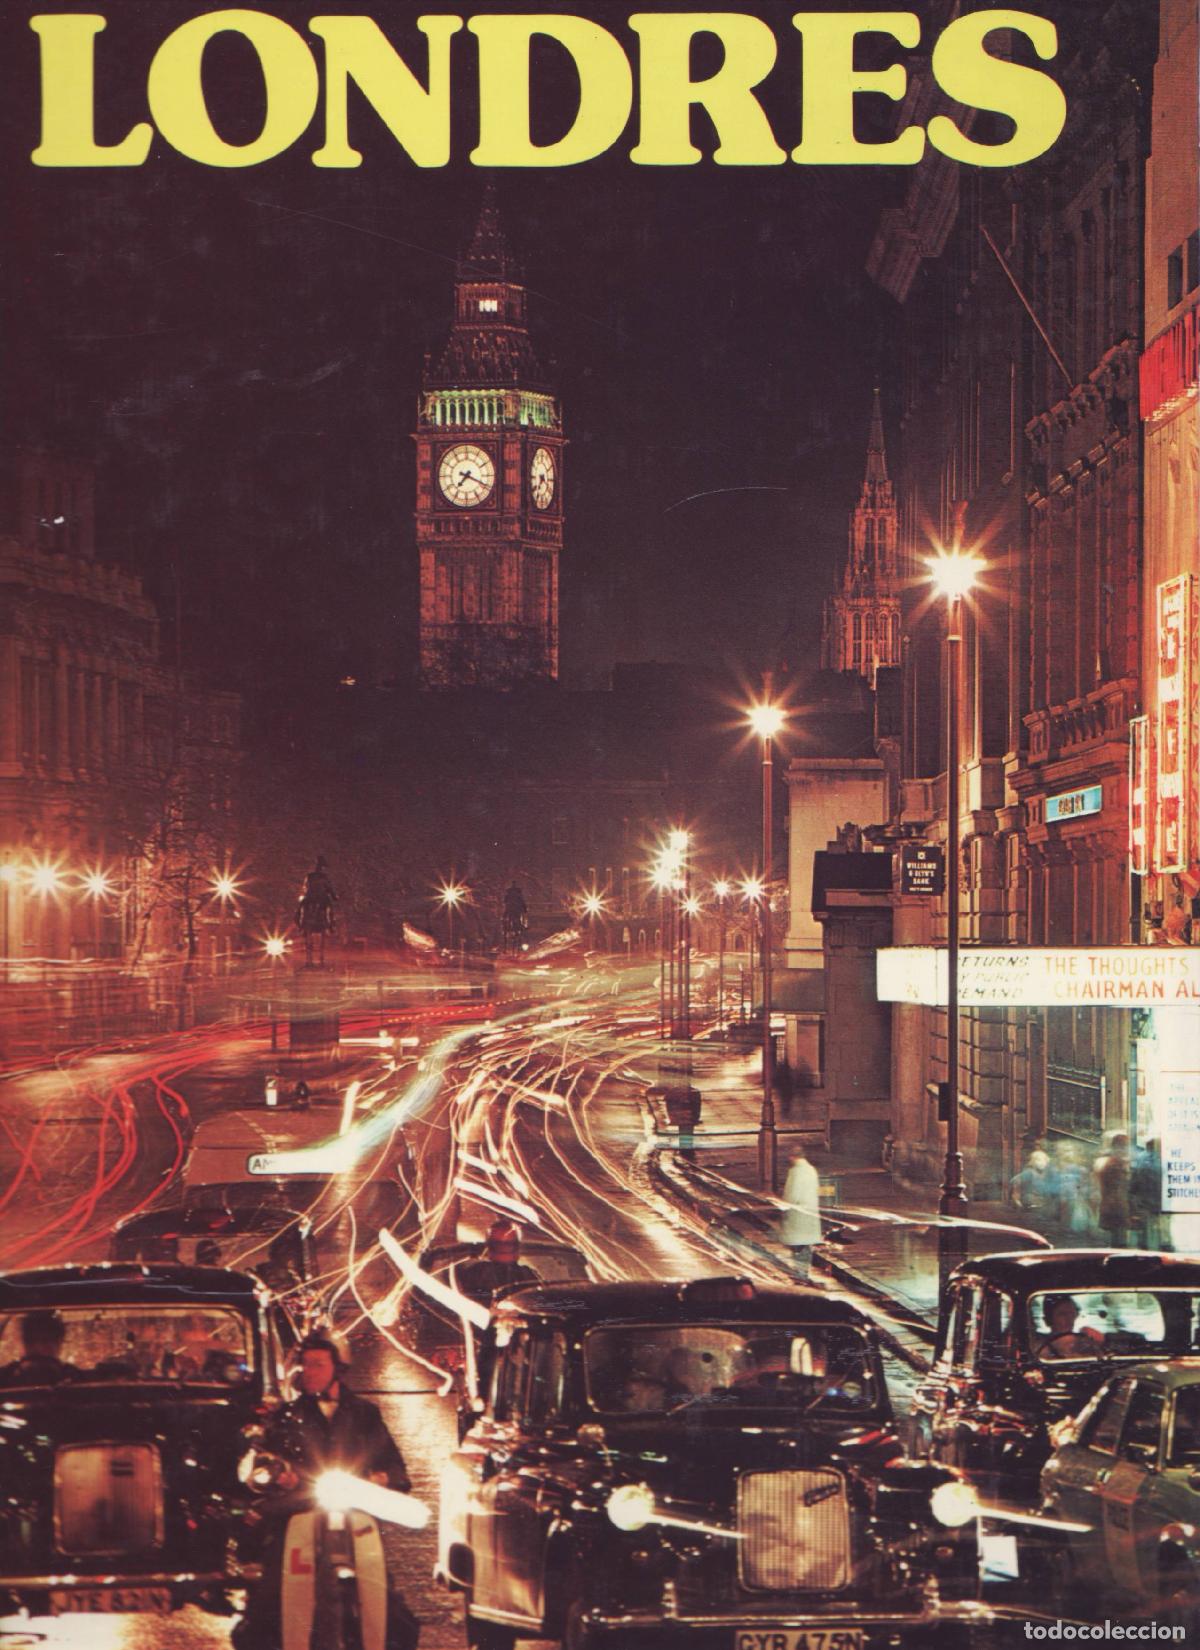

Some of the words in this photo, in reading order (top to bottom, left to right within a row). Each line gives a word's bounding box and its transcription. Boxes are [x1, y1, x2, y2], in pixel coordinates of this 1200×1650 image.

[959, 956, 1029, 967] ETURNS
[1044, 956, 1078, 976] THE
[1088, 956, 1190, 976] THOUGHTS
[1054, 979, 1164, 999] CHAIRMAN
[1168, 1162, 1196, 1172] KEEPS
[1168, 1175, 1190, 1185] THEM
[291, 1548, 312, 1575] L
